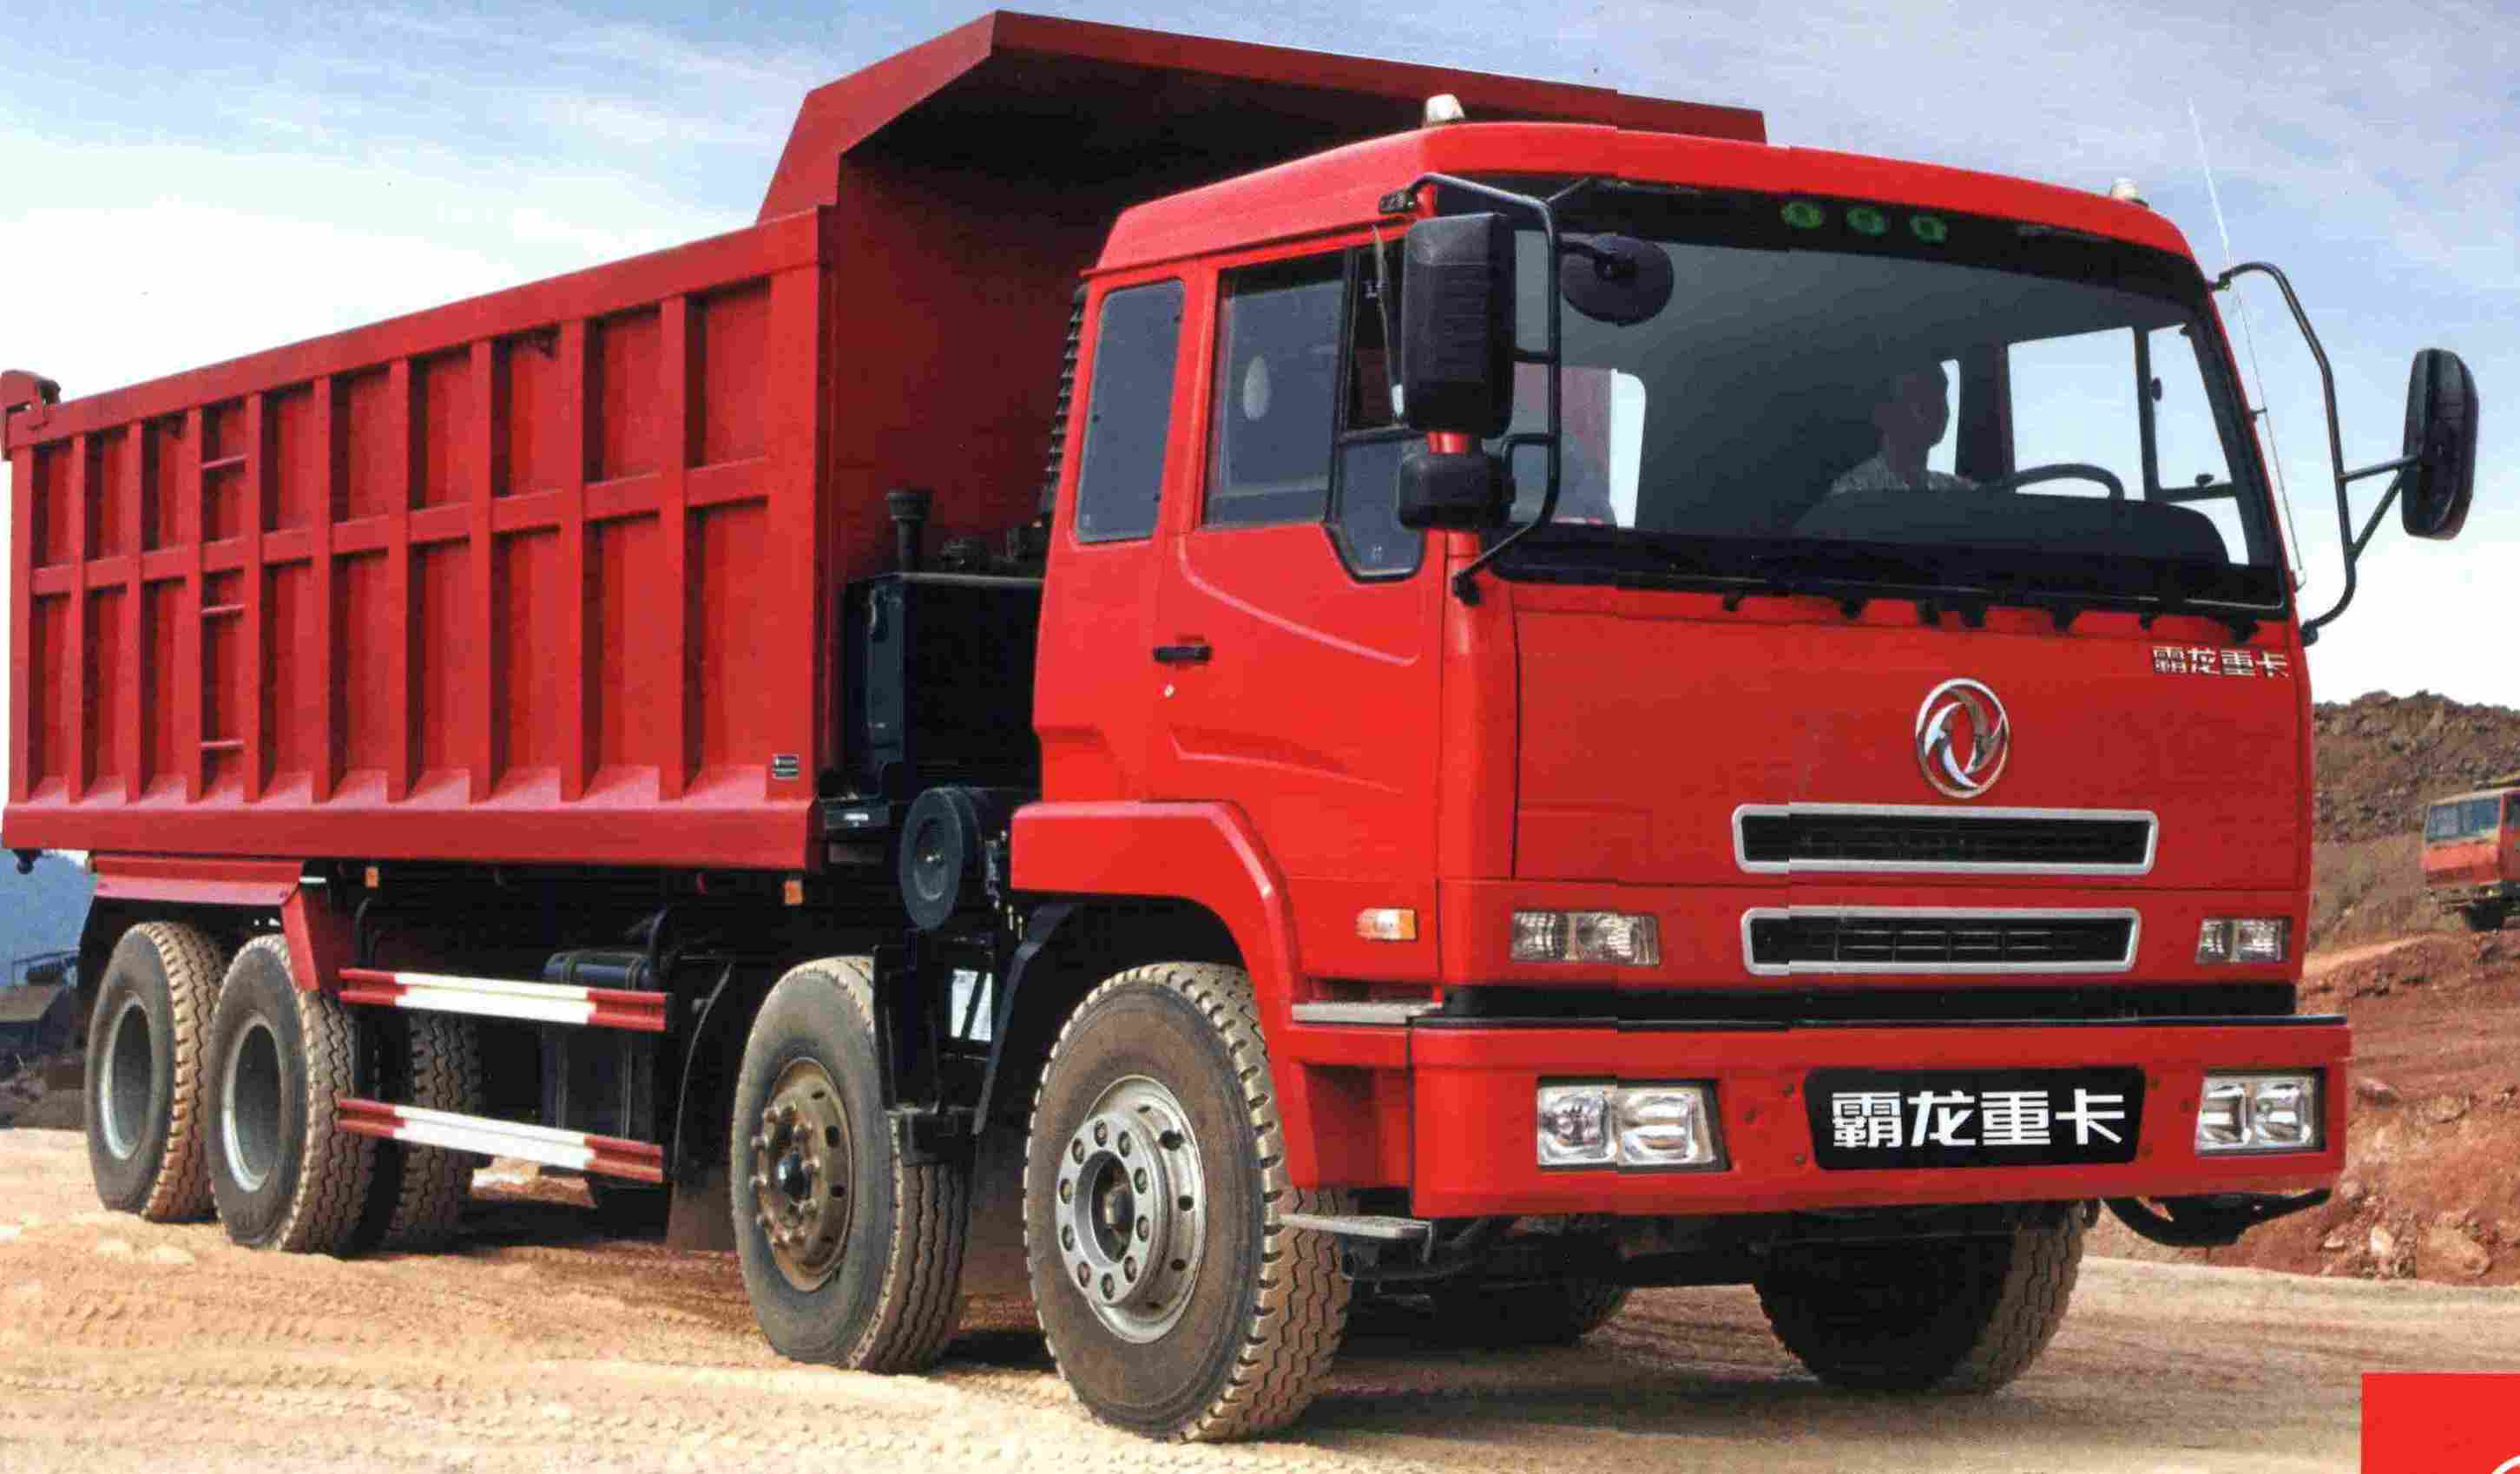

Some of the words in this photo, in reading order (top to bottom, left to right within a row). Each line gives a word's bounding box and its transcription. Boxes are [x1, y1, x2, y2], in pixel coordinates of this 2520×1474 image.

[2153, 646, 2291, 678] 霸龙重卡
[1832, 1089, 2125, 1148] 霸龙重卡
